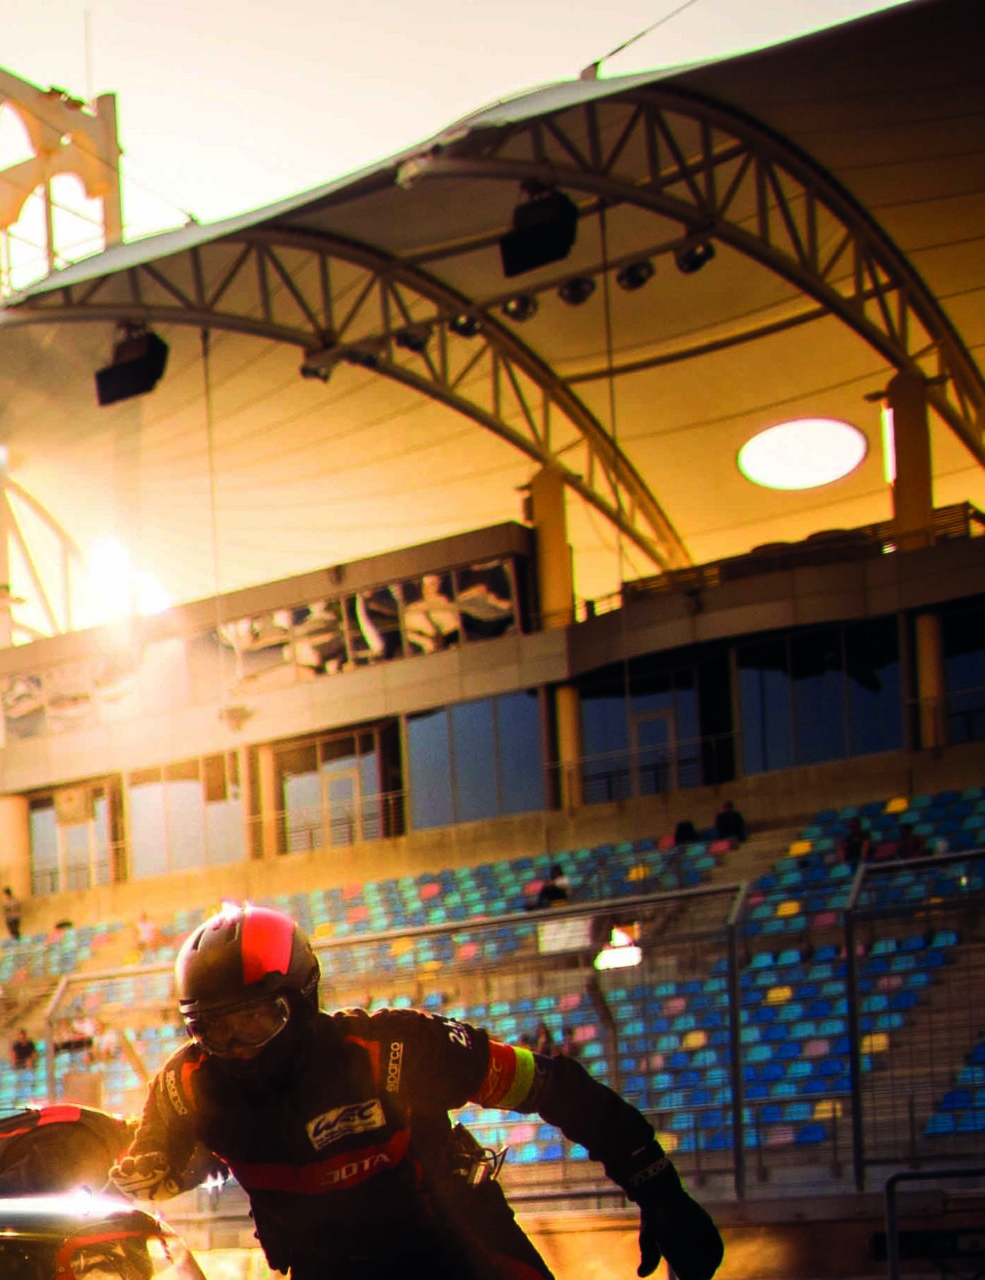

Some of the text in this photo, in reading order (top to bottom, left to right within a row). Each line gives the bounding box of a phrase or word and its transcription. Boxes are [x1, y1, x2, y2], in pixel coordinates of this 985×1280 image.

[386, 1041, 404, 1093] sparco
[165, 1069, 188, 1117] sparco
[312, 1101, 378, 1138] WEC
[319, 1153, 391, 1186] JOTA
